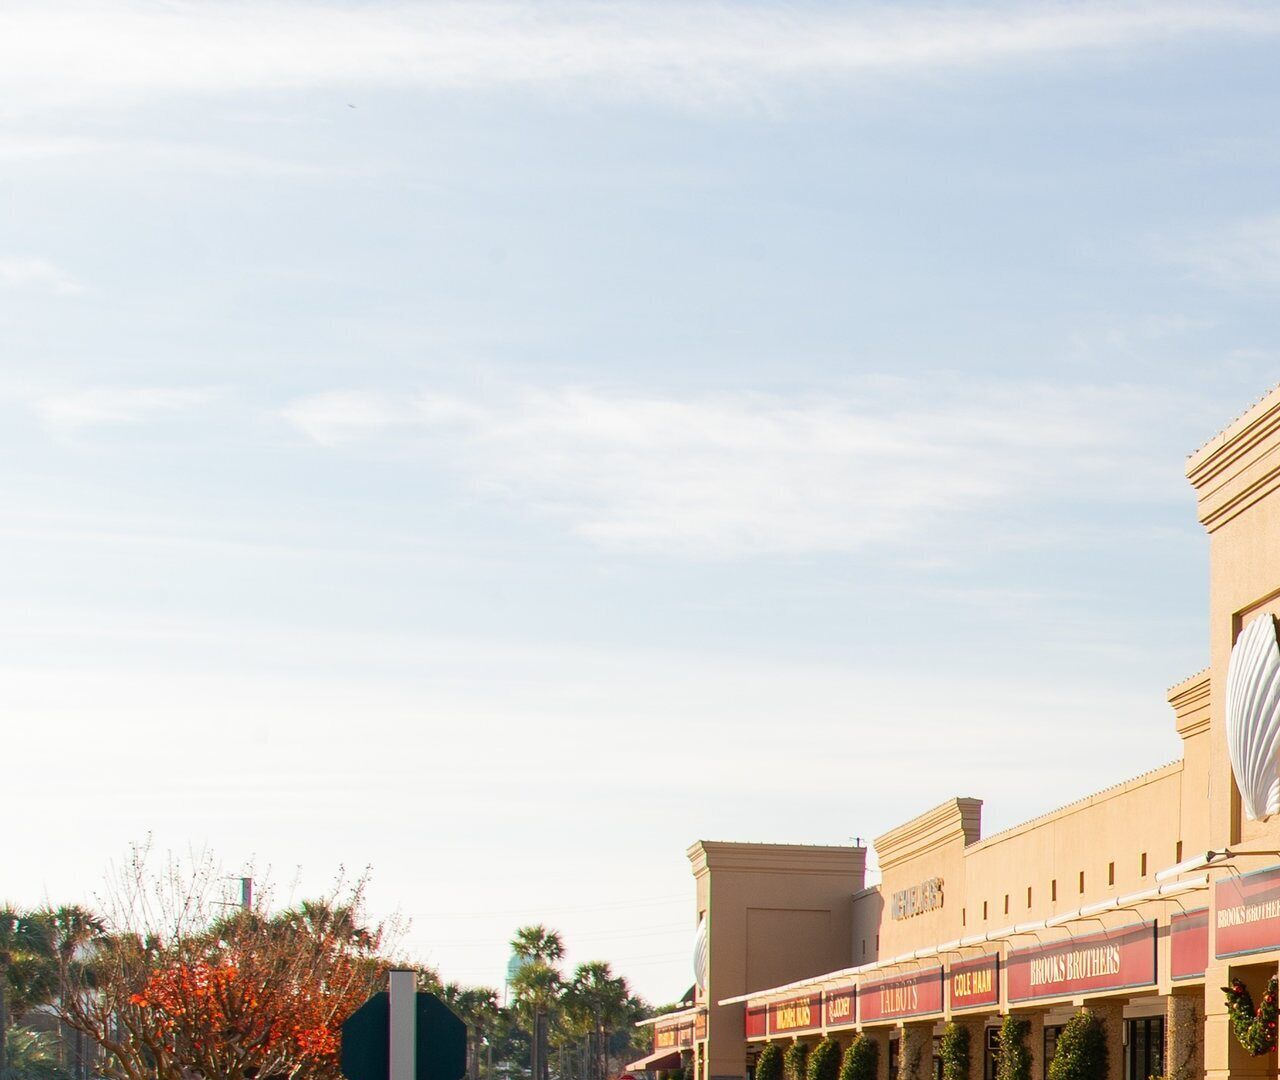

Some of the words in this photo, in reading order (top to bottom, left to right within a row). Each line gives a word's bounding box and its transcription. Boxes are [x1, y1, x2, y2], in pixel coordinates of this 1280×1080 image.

[1217, 905, 1246, 929] BROOKS
[1030, 954, 1066, 986] BROOKS
[1067, 943, 1121, 981] BROTHERS
[880, 979, 919, 1014] TALBOTS
[954, 972, 972, 997] COLE
[972, 968, 992, 995] HAAN
